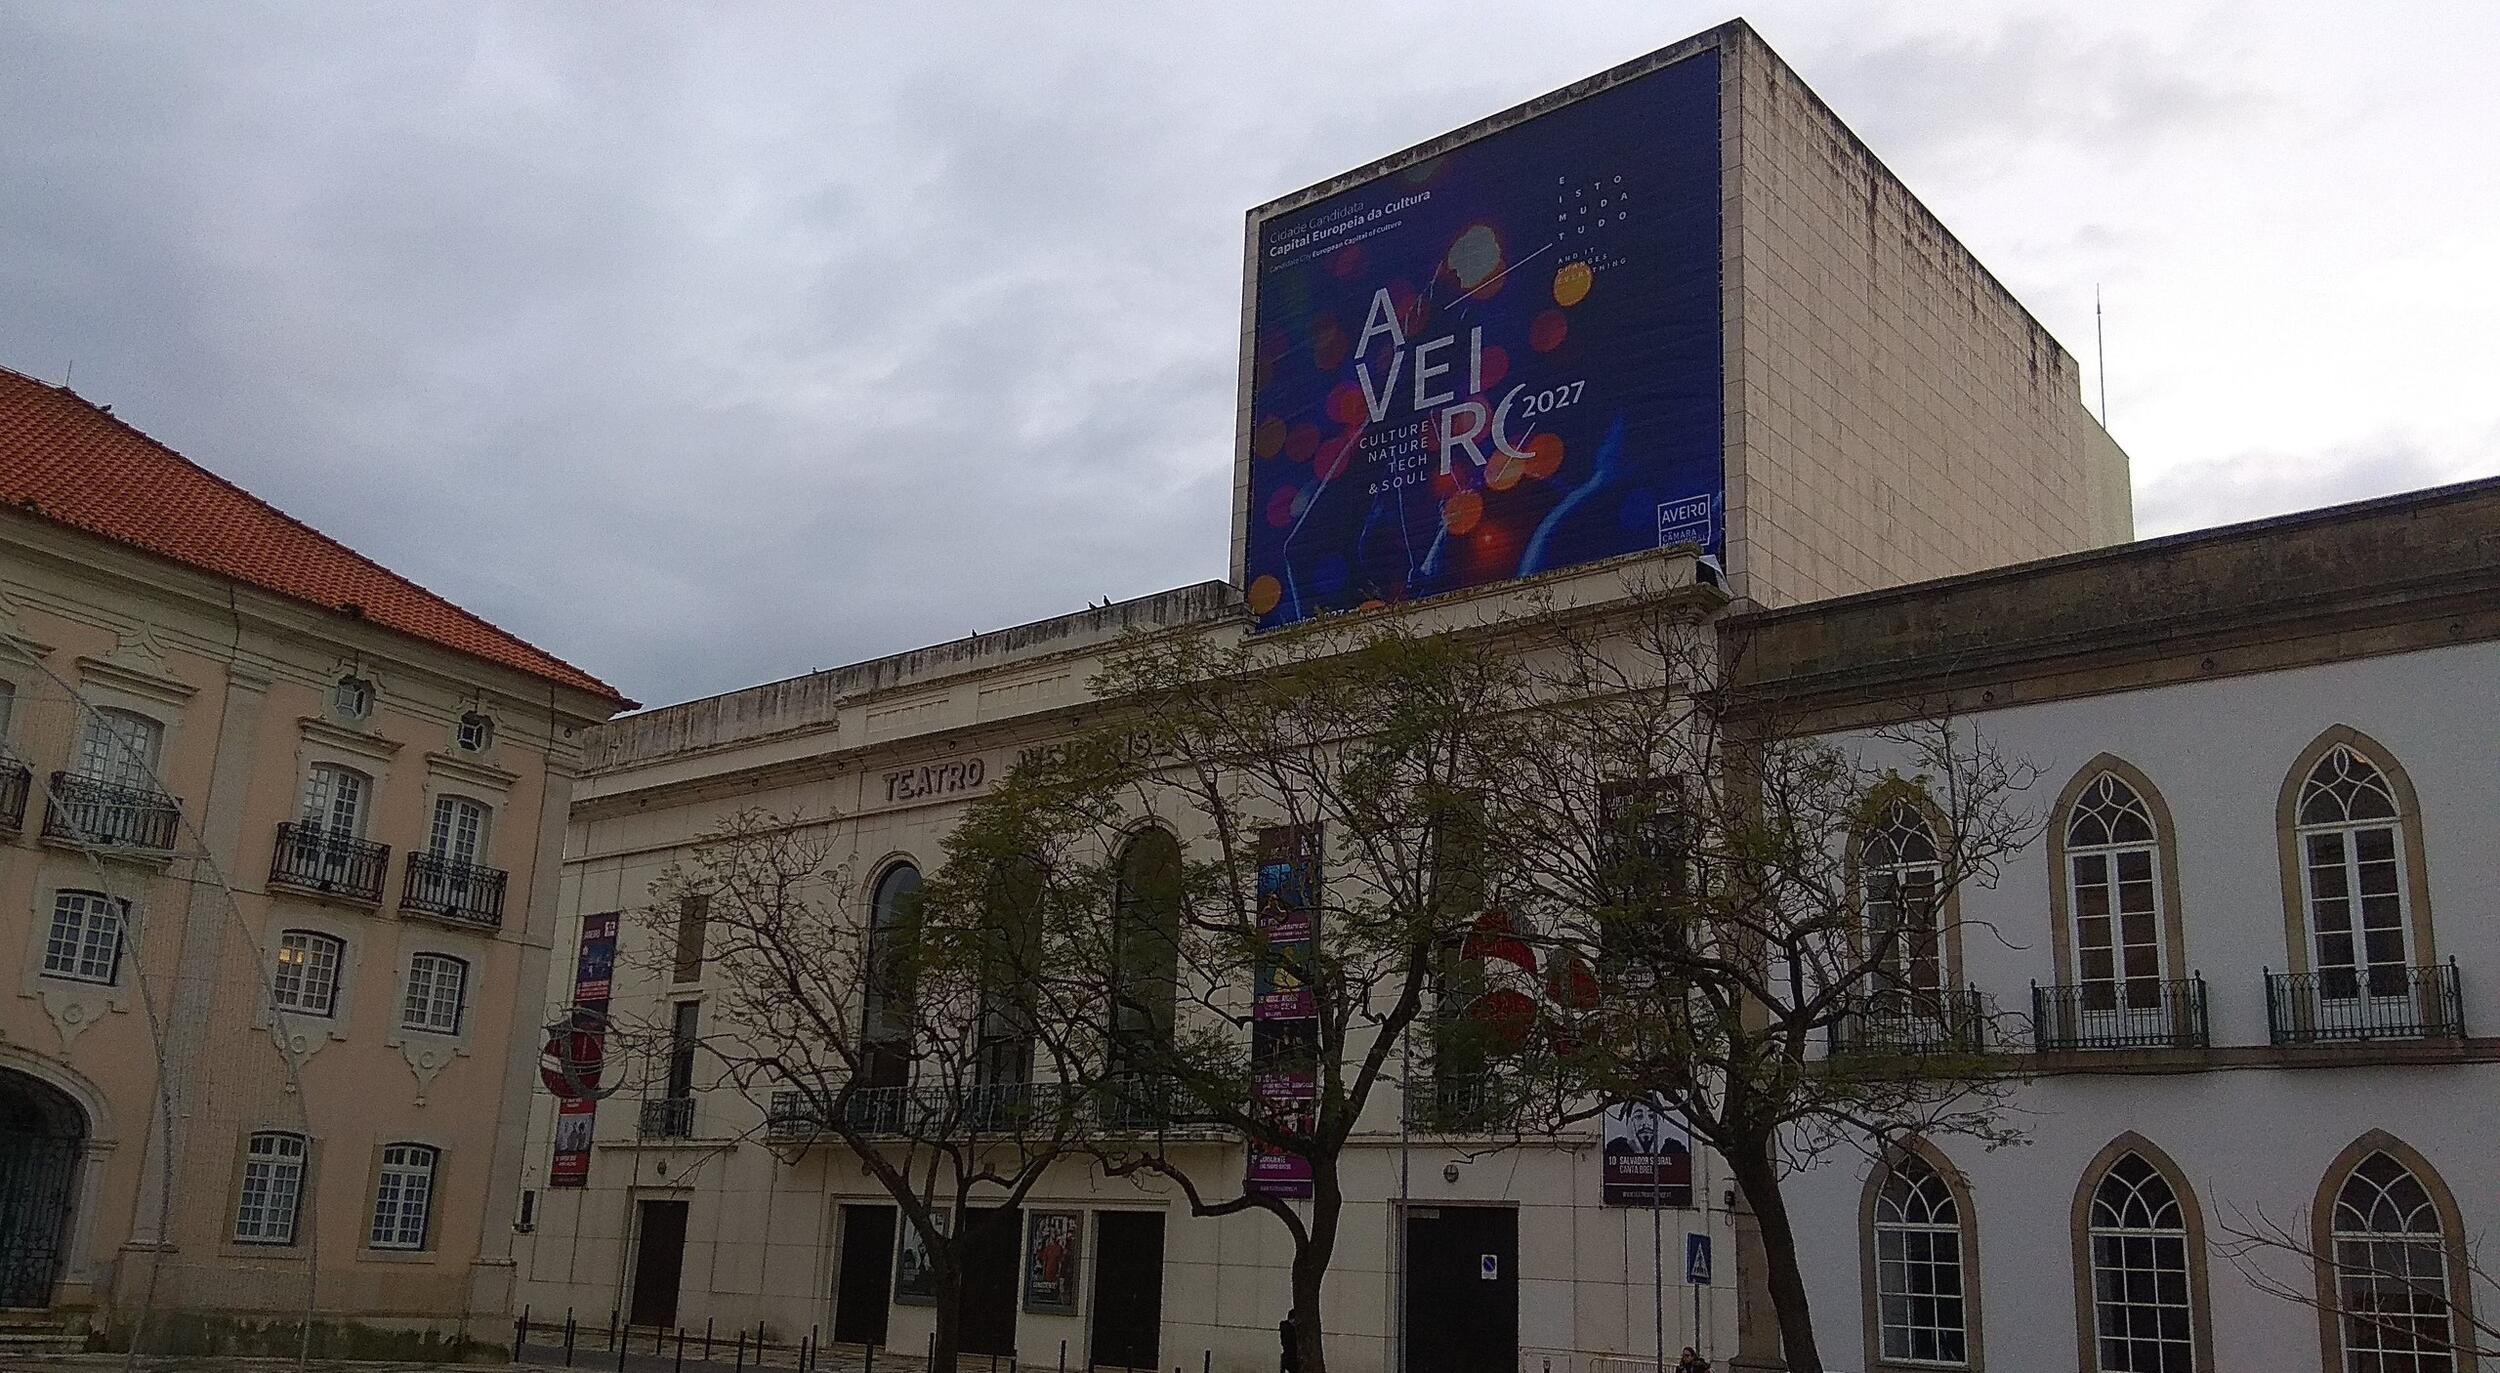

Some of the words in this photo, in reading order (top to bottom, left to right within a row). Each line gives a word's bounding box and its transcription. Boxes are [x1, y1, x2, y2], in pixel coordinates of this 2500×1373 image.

[1270, 222, 1307, 243] Cidade
[1309, 201, 1365, 230] Candidata
[1558, 192, 1628, 222] MUDA
[1270, 233, 1310, 258] Capital
[1312, 215, 1365, 243] Europeia
[1367, 208, 1382, 222] da
[1385, 190, 1431, 215] Cultura
[1558, 211, 1627, 241] TUDO
[1312, 241, 1344, 259] European
[1344, 231, 1368, 247] Capital
[1368, 229, 1376, 238] of
[1557, 252, 1578, 265] AND
[1584, 247, 1595, 256] IT
[1521, 380, 1587, 419] 2027
[1359, 419, 1430, 450] CULTURE
[1367, 436, 1430, 463] NATURE
[1388, 453, 1428, 474] TECH
[1661, 502, 1706, 524] AVEIRO
[882, 757, 986, 802] TEATRO
[1608, 1156, 1617, 1166] 10
[1619, 1156, 1649, 1166] SALVADOR
[1619, 1165, 1639, 1174] CANTA
